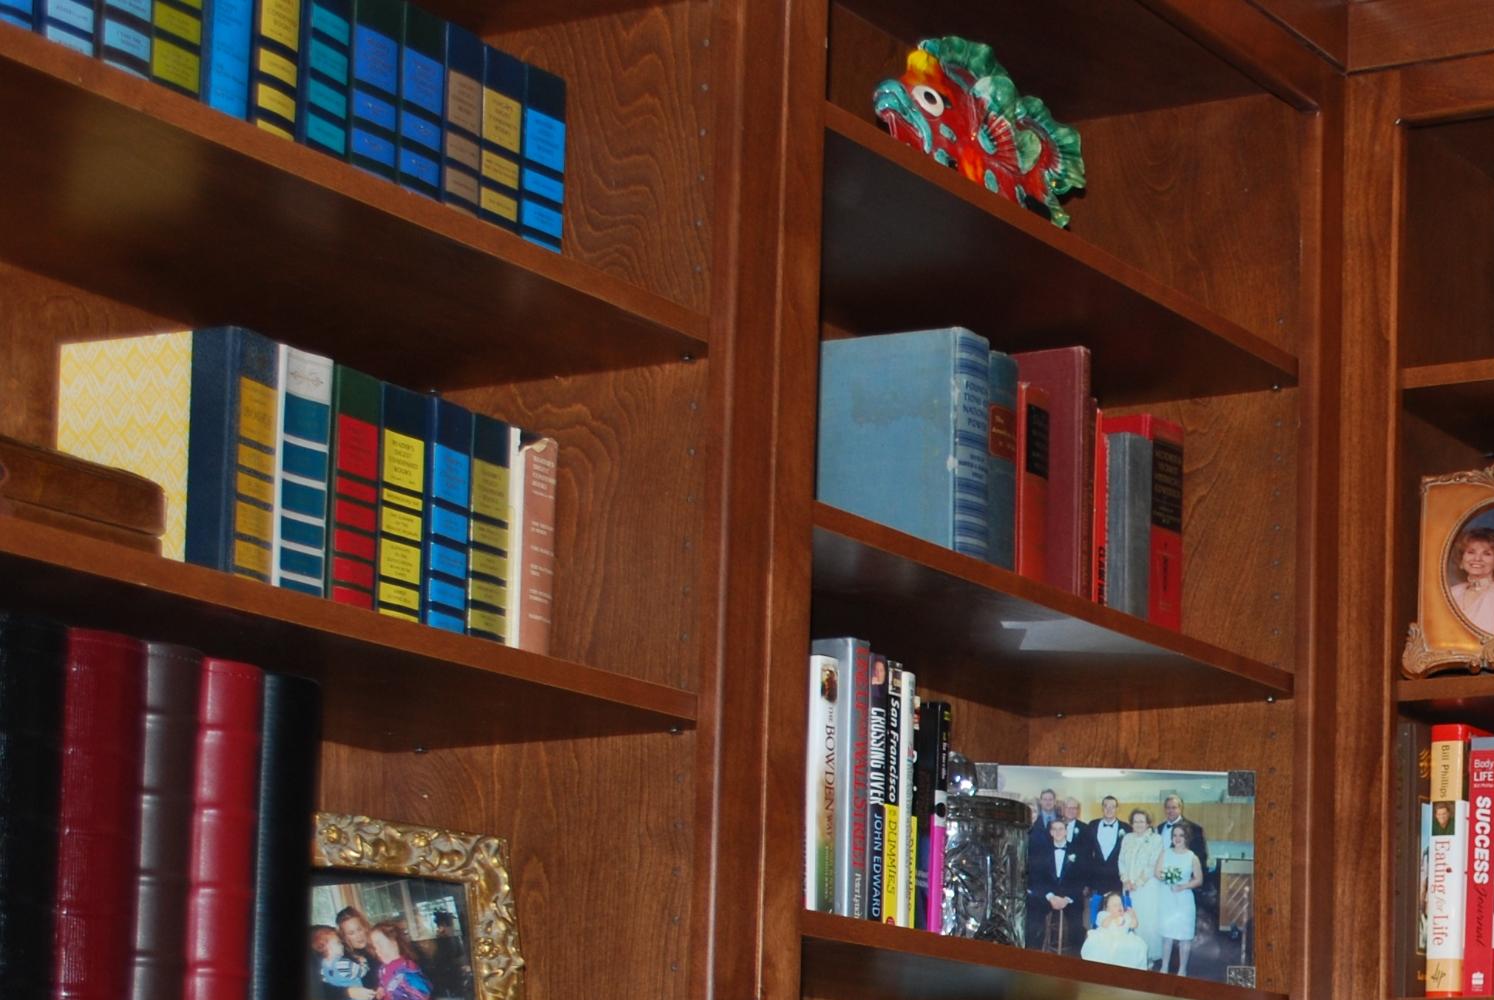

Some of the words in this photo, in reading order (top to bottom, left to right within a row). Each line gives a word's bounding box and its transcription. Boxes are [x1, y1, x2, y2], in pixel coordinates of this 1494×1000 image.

[890, 697, 901, 727] San
[870, 707, 887, 768] CROSSING
[1440, 744, 1450, 760] Bill
[823, 724, 837, 811] BOWDEN
[853, 741, 867, 793] WALL
[889, 730, 900, 803] Francisco
[1439, 764, 1450, 799] Phillips
[1473, 758, 1494, 769] Body
[1473, 771, 1494, 781] LIFE
[869, 771, 886, 805] OVER
[825, 814, 834, 837] WAY
[852, 798, 866, 870] STREET
[872, 814, 884, 851] JOHN
[1473, 796, 1492, 884] SUCCESS
[886, 819, 898, 896] DUMMIES
[1431, 840, 1451, 895] Eating
[871, 855, 883, 917] EDWARD
[1432, 915, 1449, 946] Life
